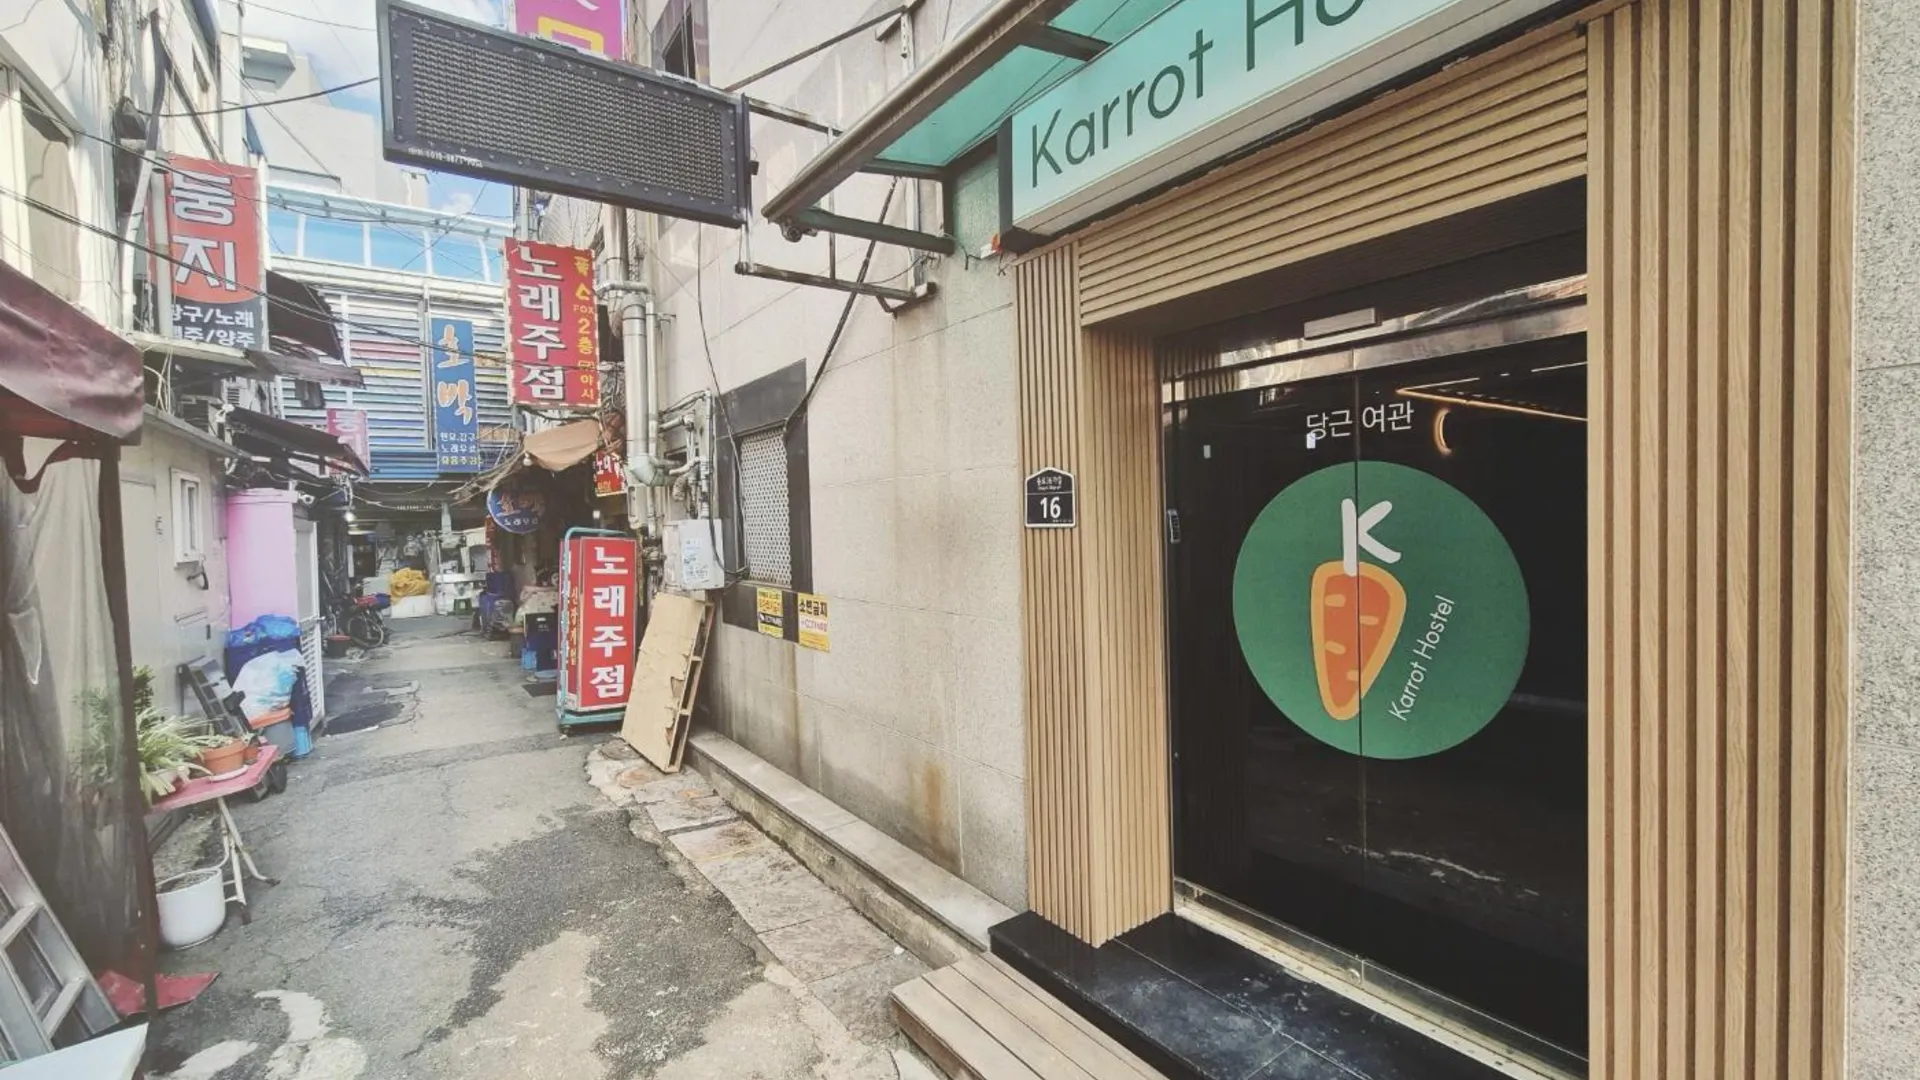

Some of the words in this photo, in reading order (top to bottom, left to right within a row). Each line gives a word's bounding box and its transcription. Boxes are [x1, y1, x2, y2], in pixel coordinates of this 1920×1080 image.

[1032, 29, 1214, 188] Karrot
[171, 170, 237, 291] 둥지
[514, 244, 576, 399] 노래주점
[573, 304, 594, 315] FOX
[436, 324, 473, 425] 호박
[1306, 410, 1353, 440] 당근
[1362, 400, 1415, 433] 여관
[1040, 496, 1061, 519] 16
[1341, 498, 1401, 577] K
[590, 546, 629, 698] 노래주점
[799, 599, 828, 617] 소변금지
[1388, 660, 1428, 721] Karrot
[1412, 594, 1456, 660] Hostel
